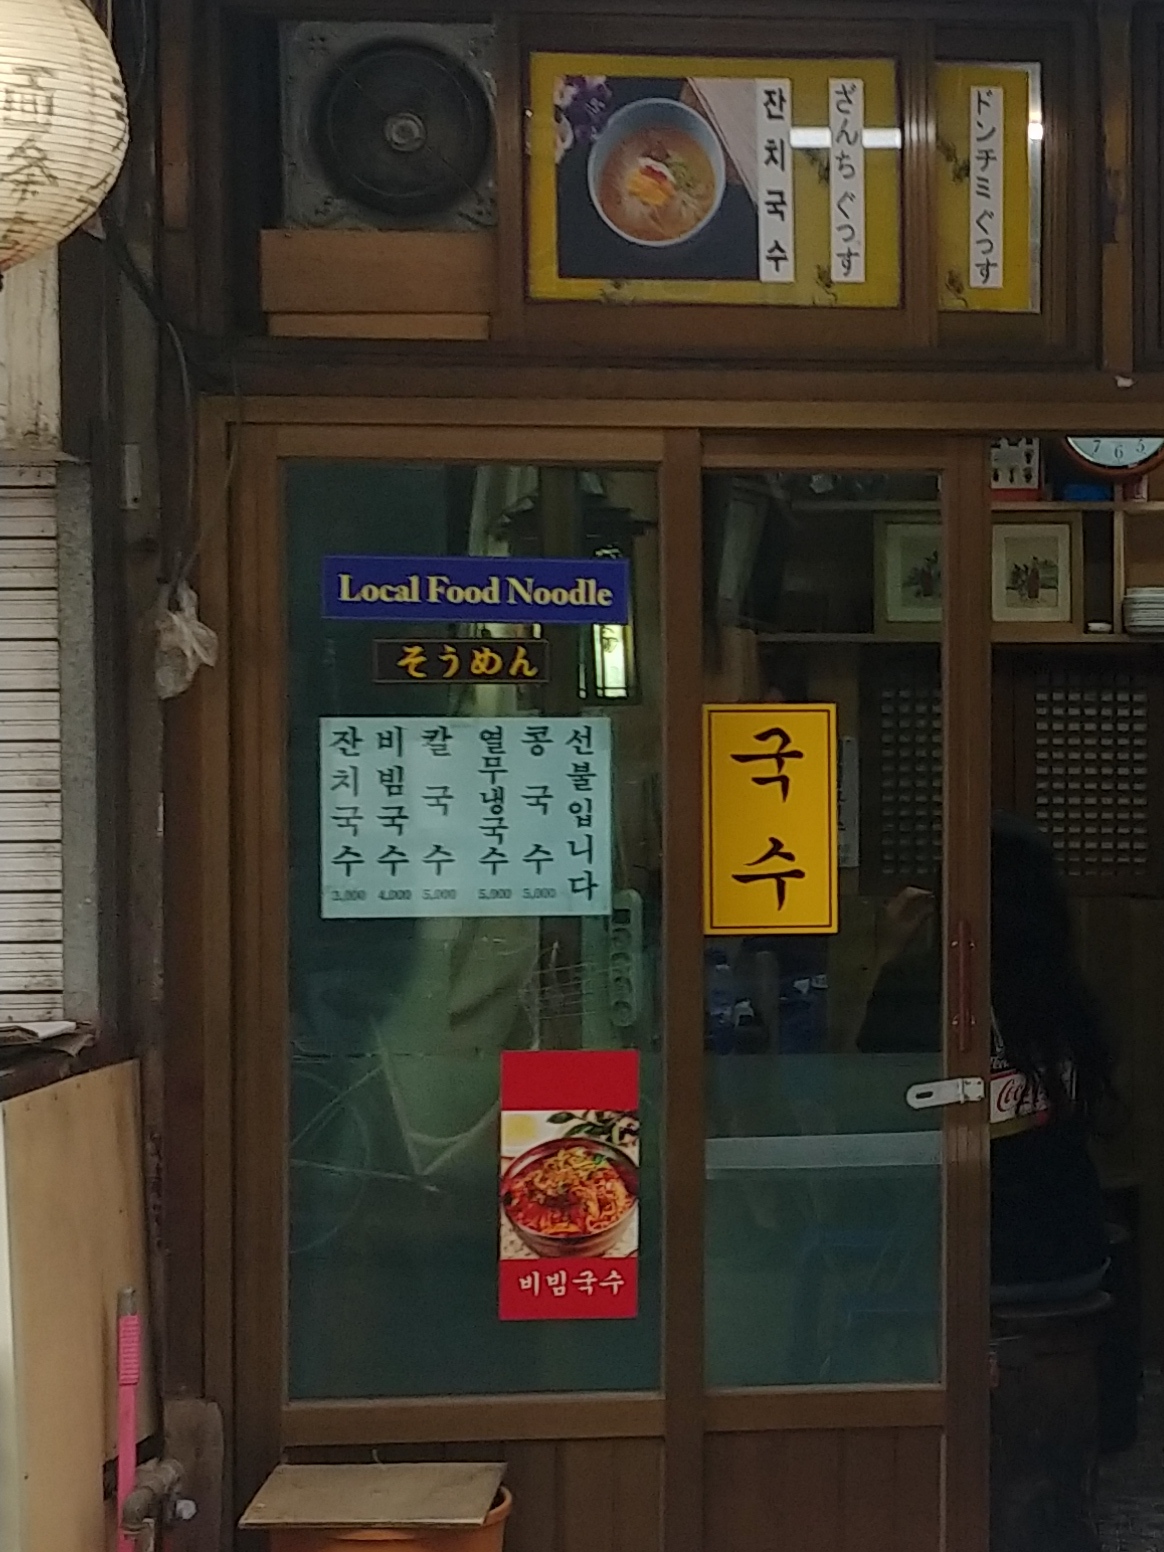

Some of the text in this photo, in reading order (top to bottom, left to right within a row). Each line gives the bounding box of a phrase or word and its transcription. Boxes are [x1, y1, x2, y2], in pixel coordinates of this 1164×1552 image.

[763, 87, 788, 273] 잔치국수
[1093, 439, 1101, 453] 7
[1113, 445, 1124, 459] 6
[338, 573, 614, 607] Local Food Noodle
[396, 643, 539, 679] そうめん
[329, 725, 365, 878] 잔치국수
[376, 725, 410, 877] 비빔국수
[421, 725, 456, 876] 칼국수
[477, 725, 510, 876] 열무냉국수
[521, 725, 555, 876] 콩국수
[564, 724, 599, 902] 선불입니다
[730, 727, 806, 912] 국수
[519, 1270, 625, 1297] 비빔국수
